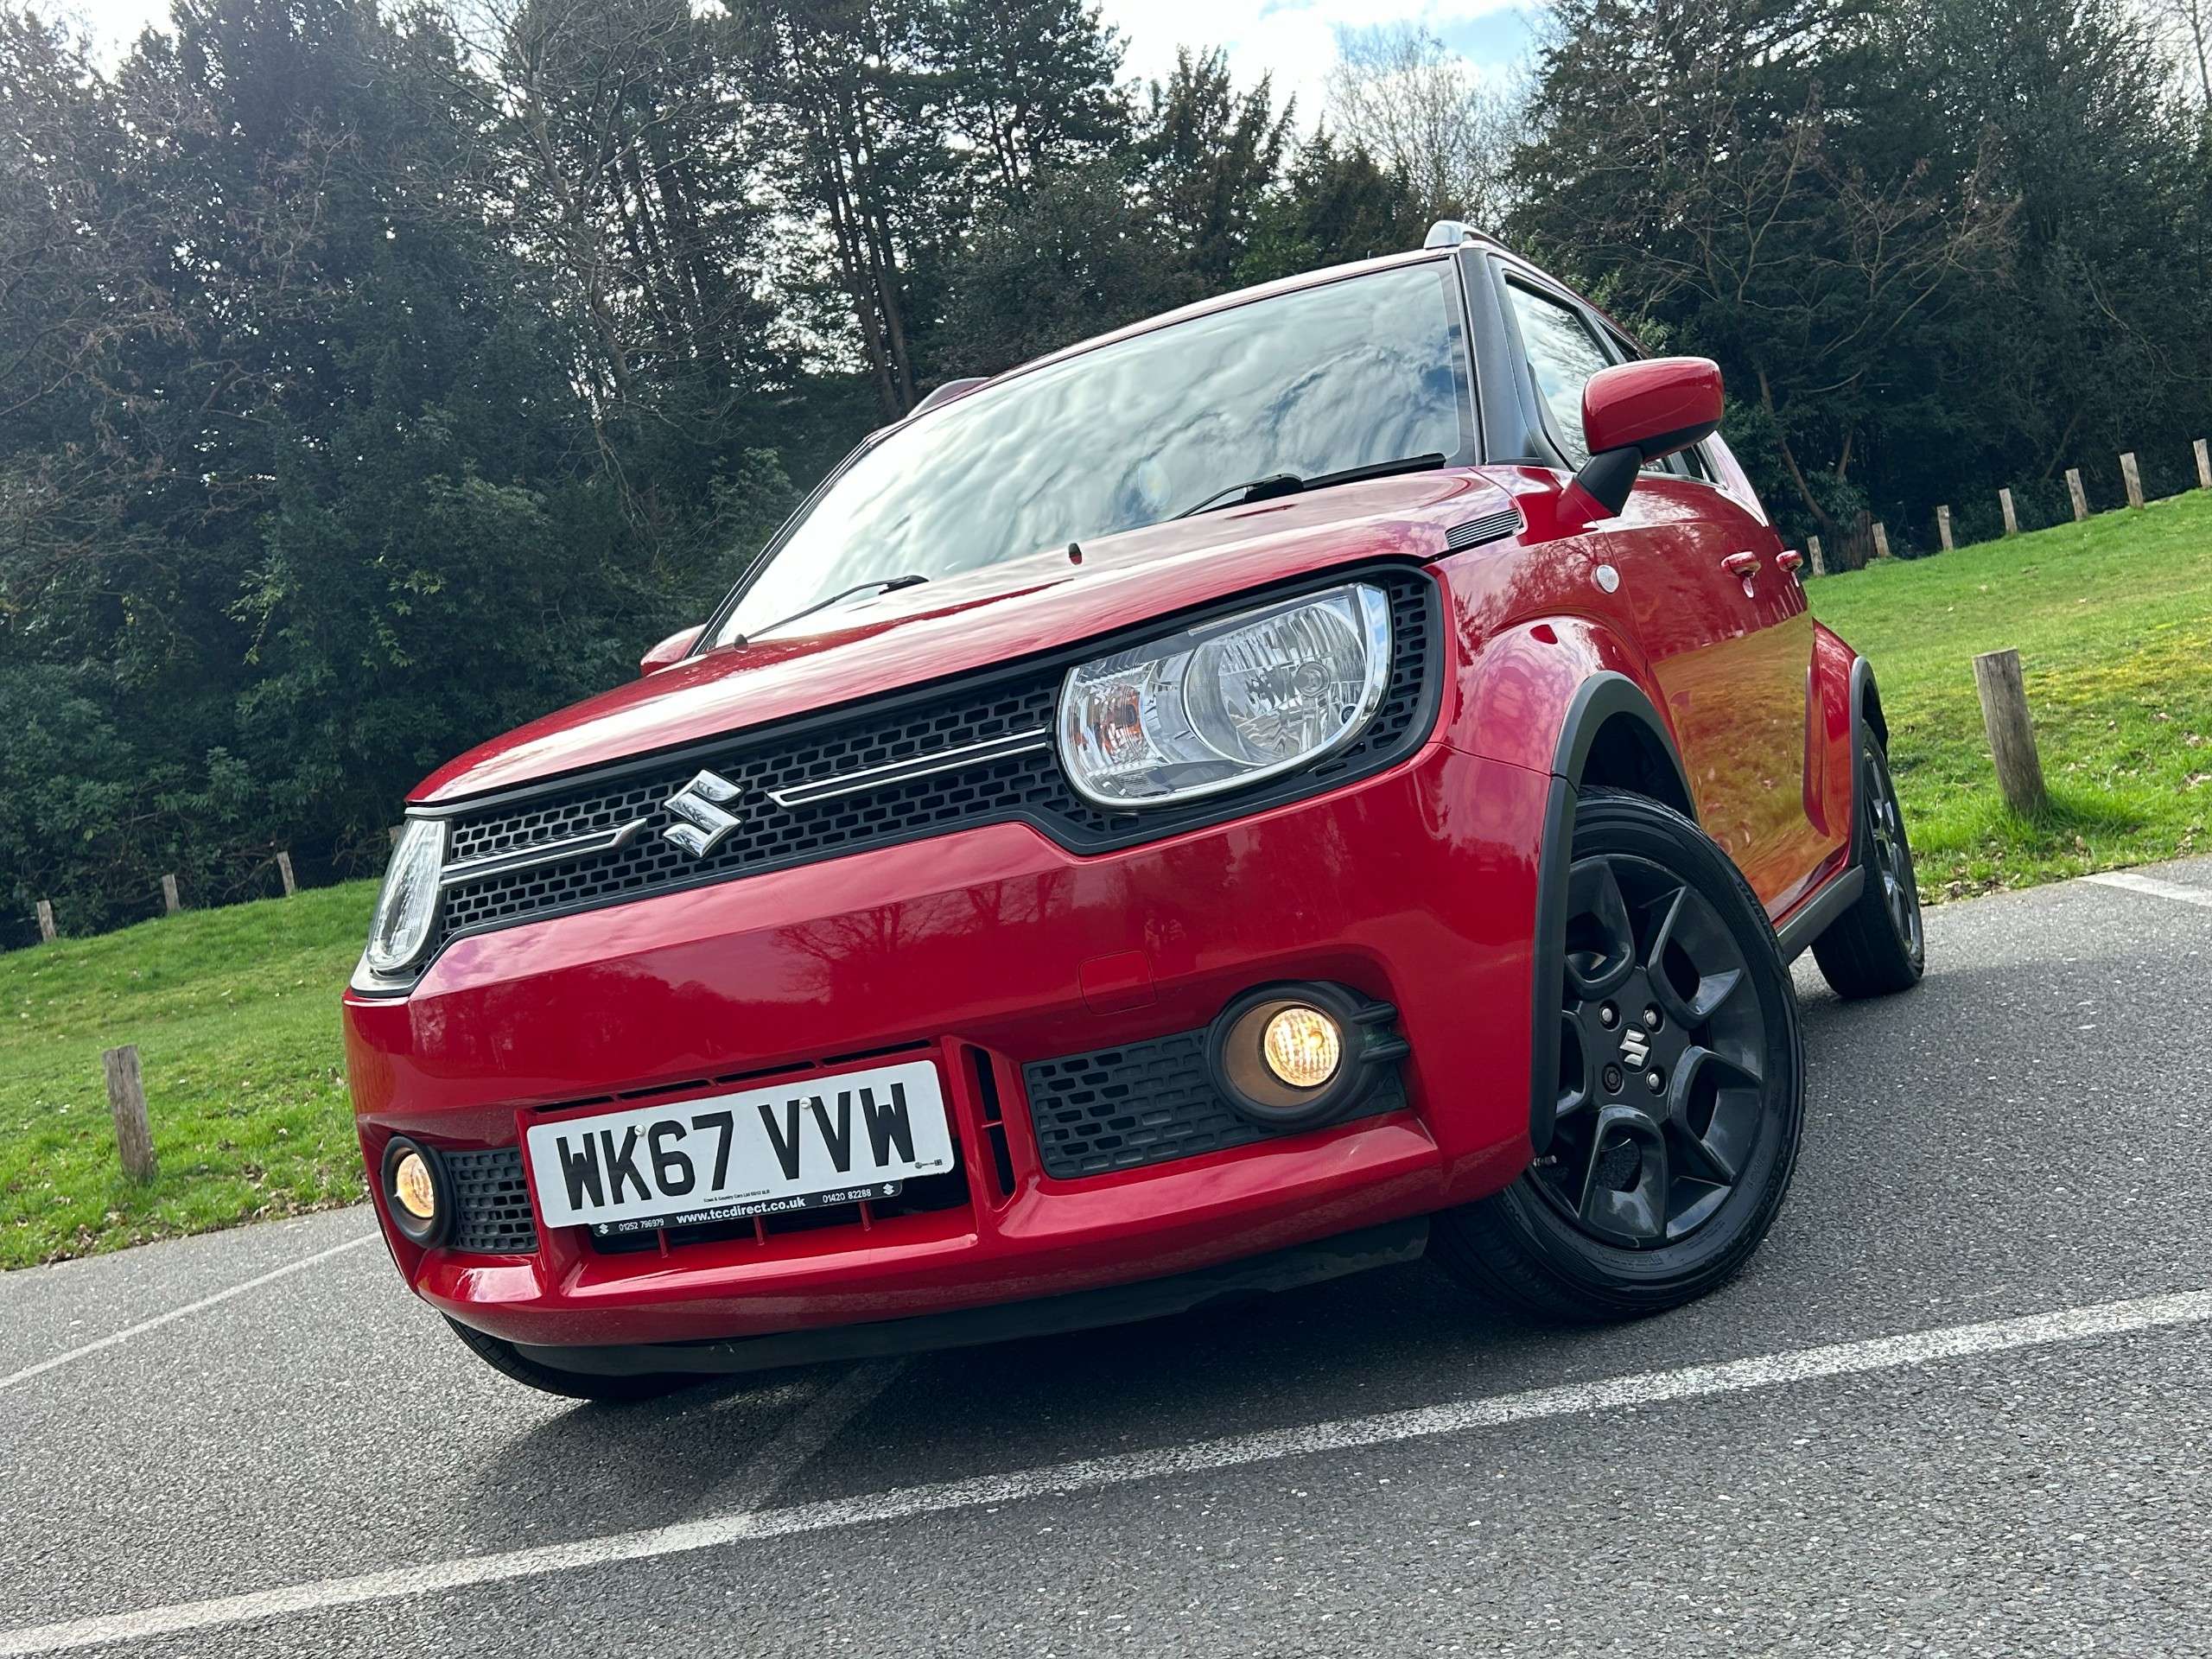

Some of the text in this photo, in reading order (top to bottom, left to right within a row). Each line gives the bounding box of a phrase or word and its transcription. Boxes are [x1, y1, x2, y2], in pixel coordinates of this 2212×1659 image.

[556, 1083, 916, 1211] WK67 VVW
[676, 1197, 806, 1224] www.tccdirect.co.uk
[822, 1192, 846, 1204] 01420
